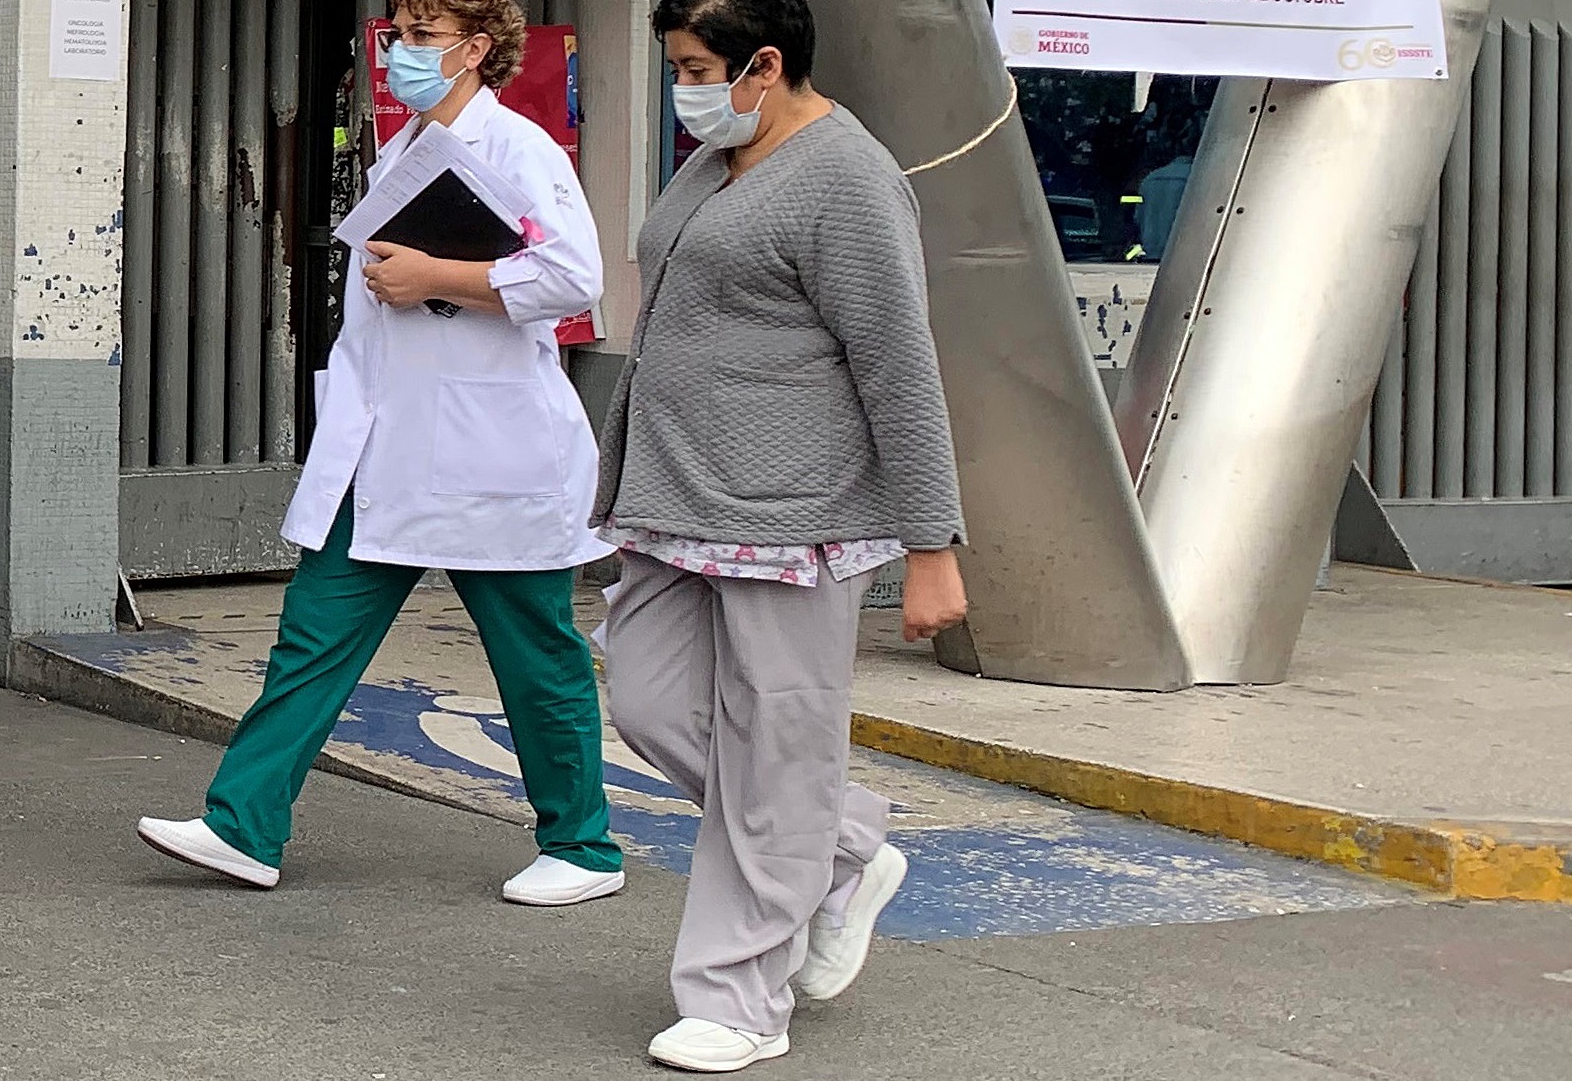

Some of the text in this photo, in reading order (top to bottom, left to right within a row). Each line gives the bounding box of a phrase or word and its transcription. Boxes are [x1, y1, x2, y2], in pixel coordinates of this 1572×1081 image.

[1038, 29, 1090, 40] GOBIERNO DE
[1038, 39, 1090, 55] MÉXICO
